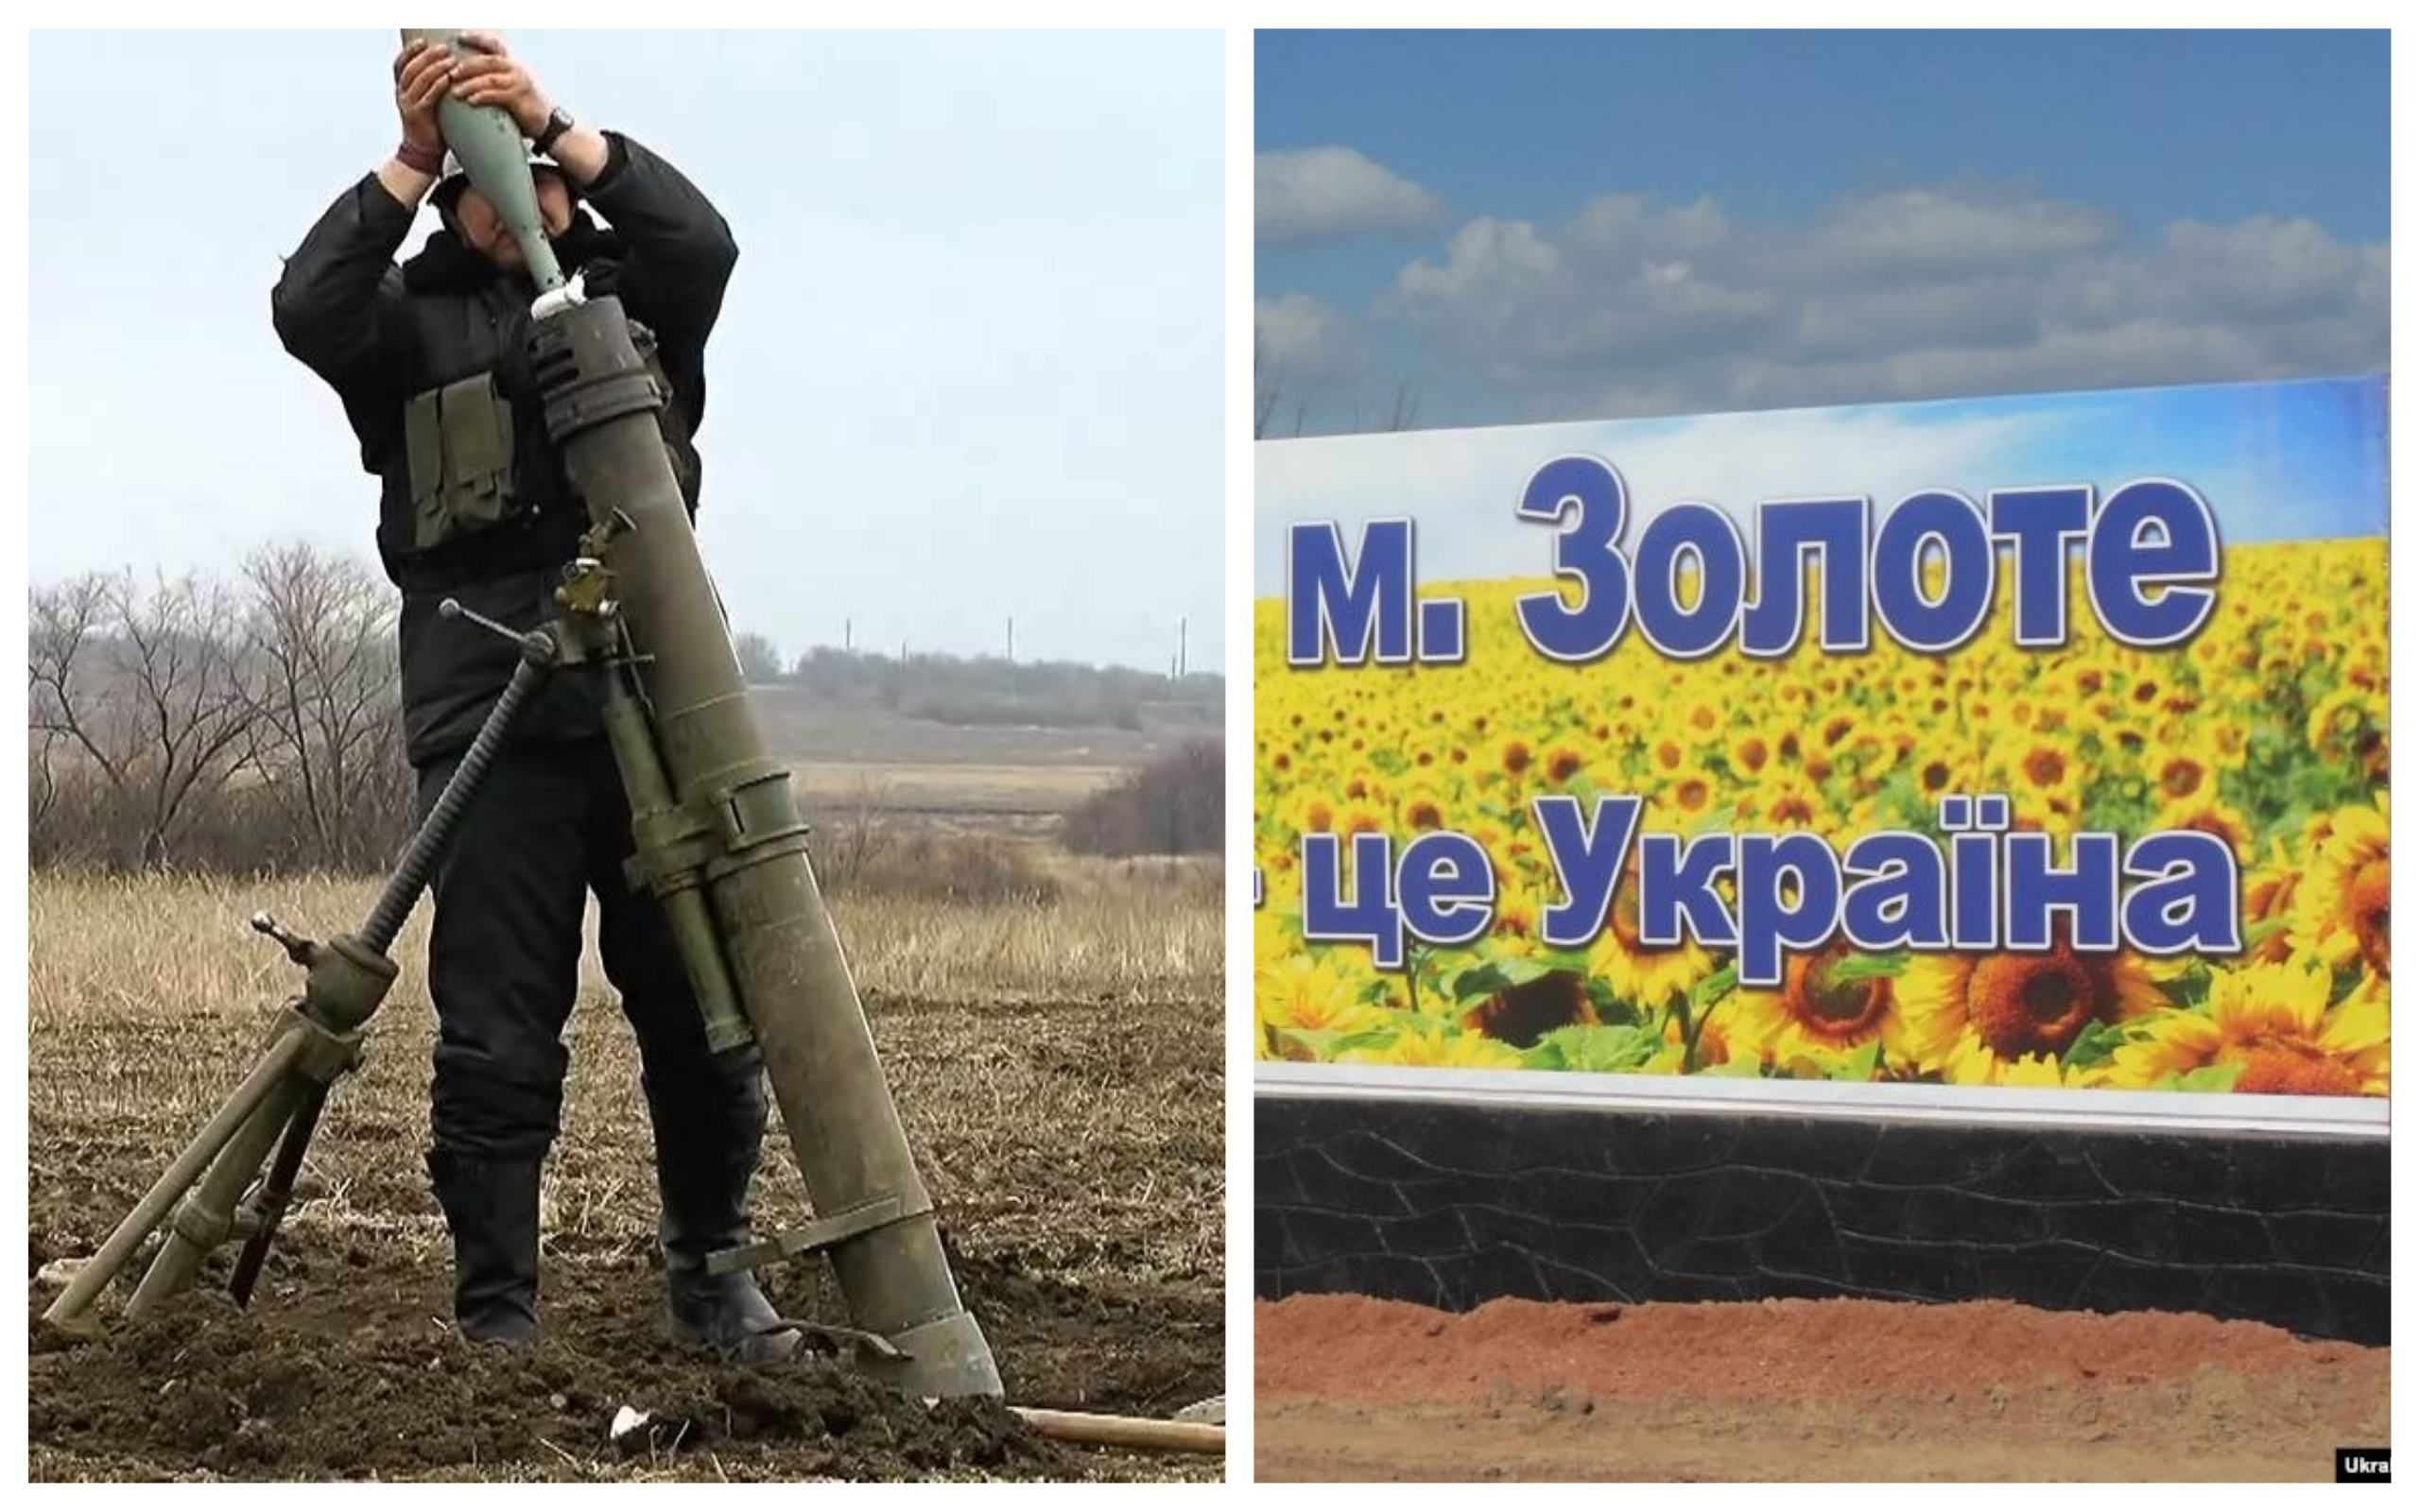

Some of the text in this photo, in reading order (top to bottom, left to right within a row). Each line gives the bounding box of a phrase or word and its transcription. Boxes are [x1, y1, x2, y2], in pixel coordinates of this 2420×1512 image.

[1288, 455, 2219, 663] м. Золоте
[1302, 795, 2241, 986] це Україна
